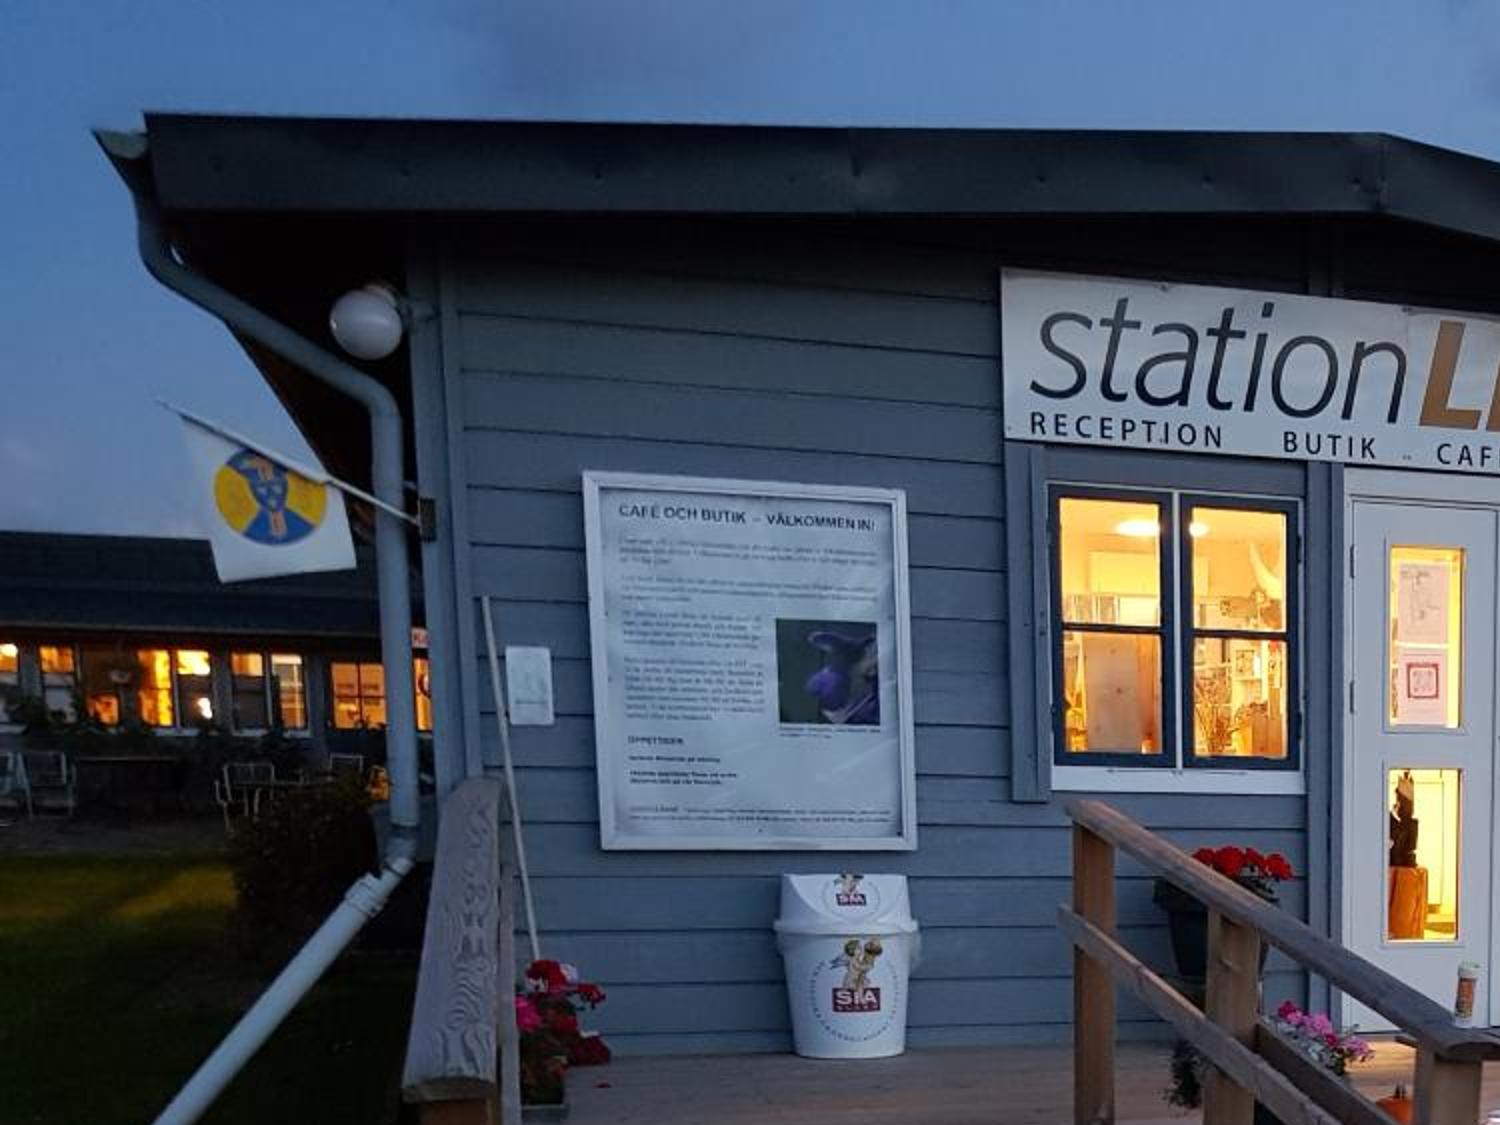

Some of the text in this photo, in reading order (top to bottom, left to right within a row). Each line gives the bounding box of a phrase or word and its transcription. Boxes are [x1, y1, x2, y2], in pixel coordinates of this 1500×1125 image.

[1029, 411, 1222, 449] RECEPTION
[1282, 430, 1376, 460] BUTIK
[662, 505, 698, 521] OCH
[700, 507, 747, 524] BUTIK
[835, 990, 877, 1005] SIA
